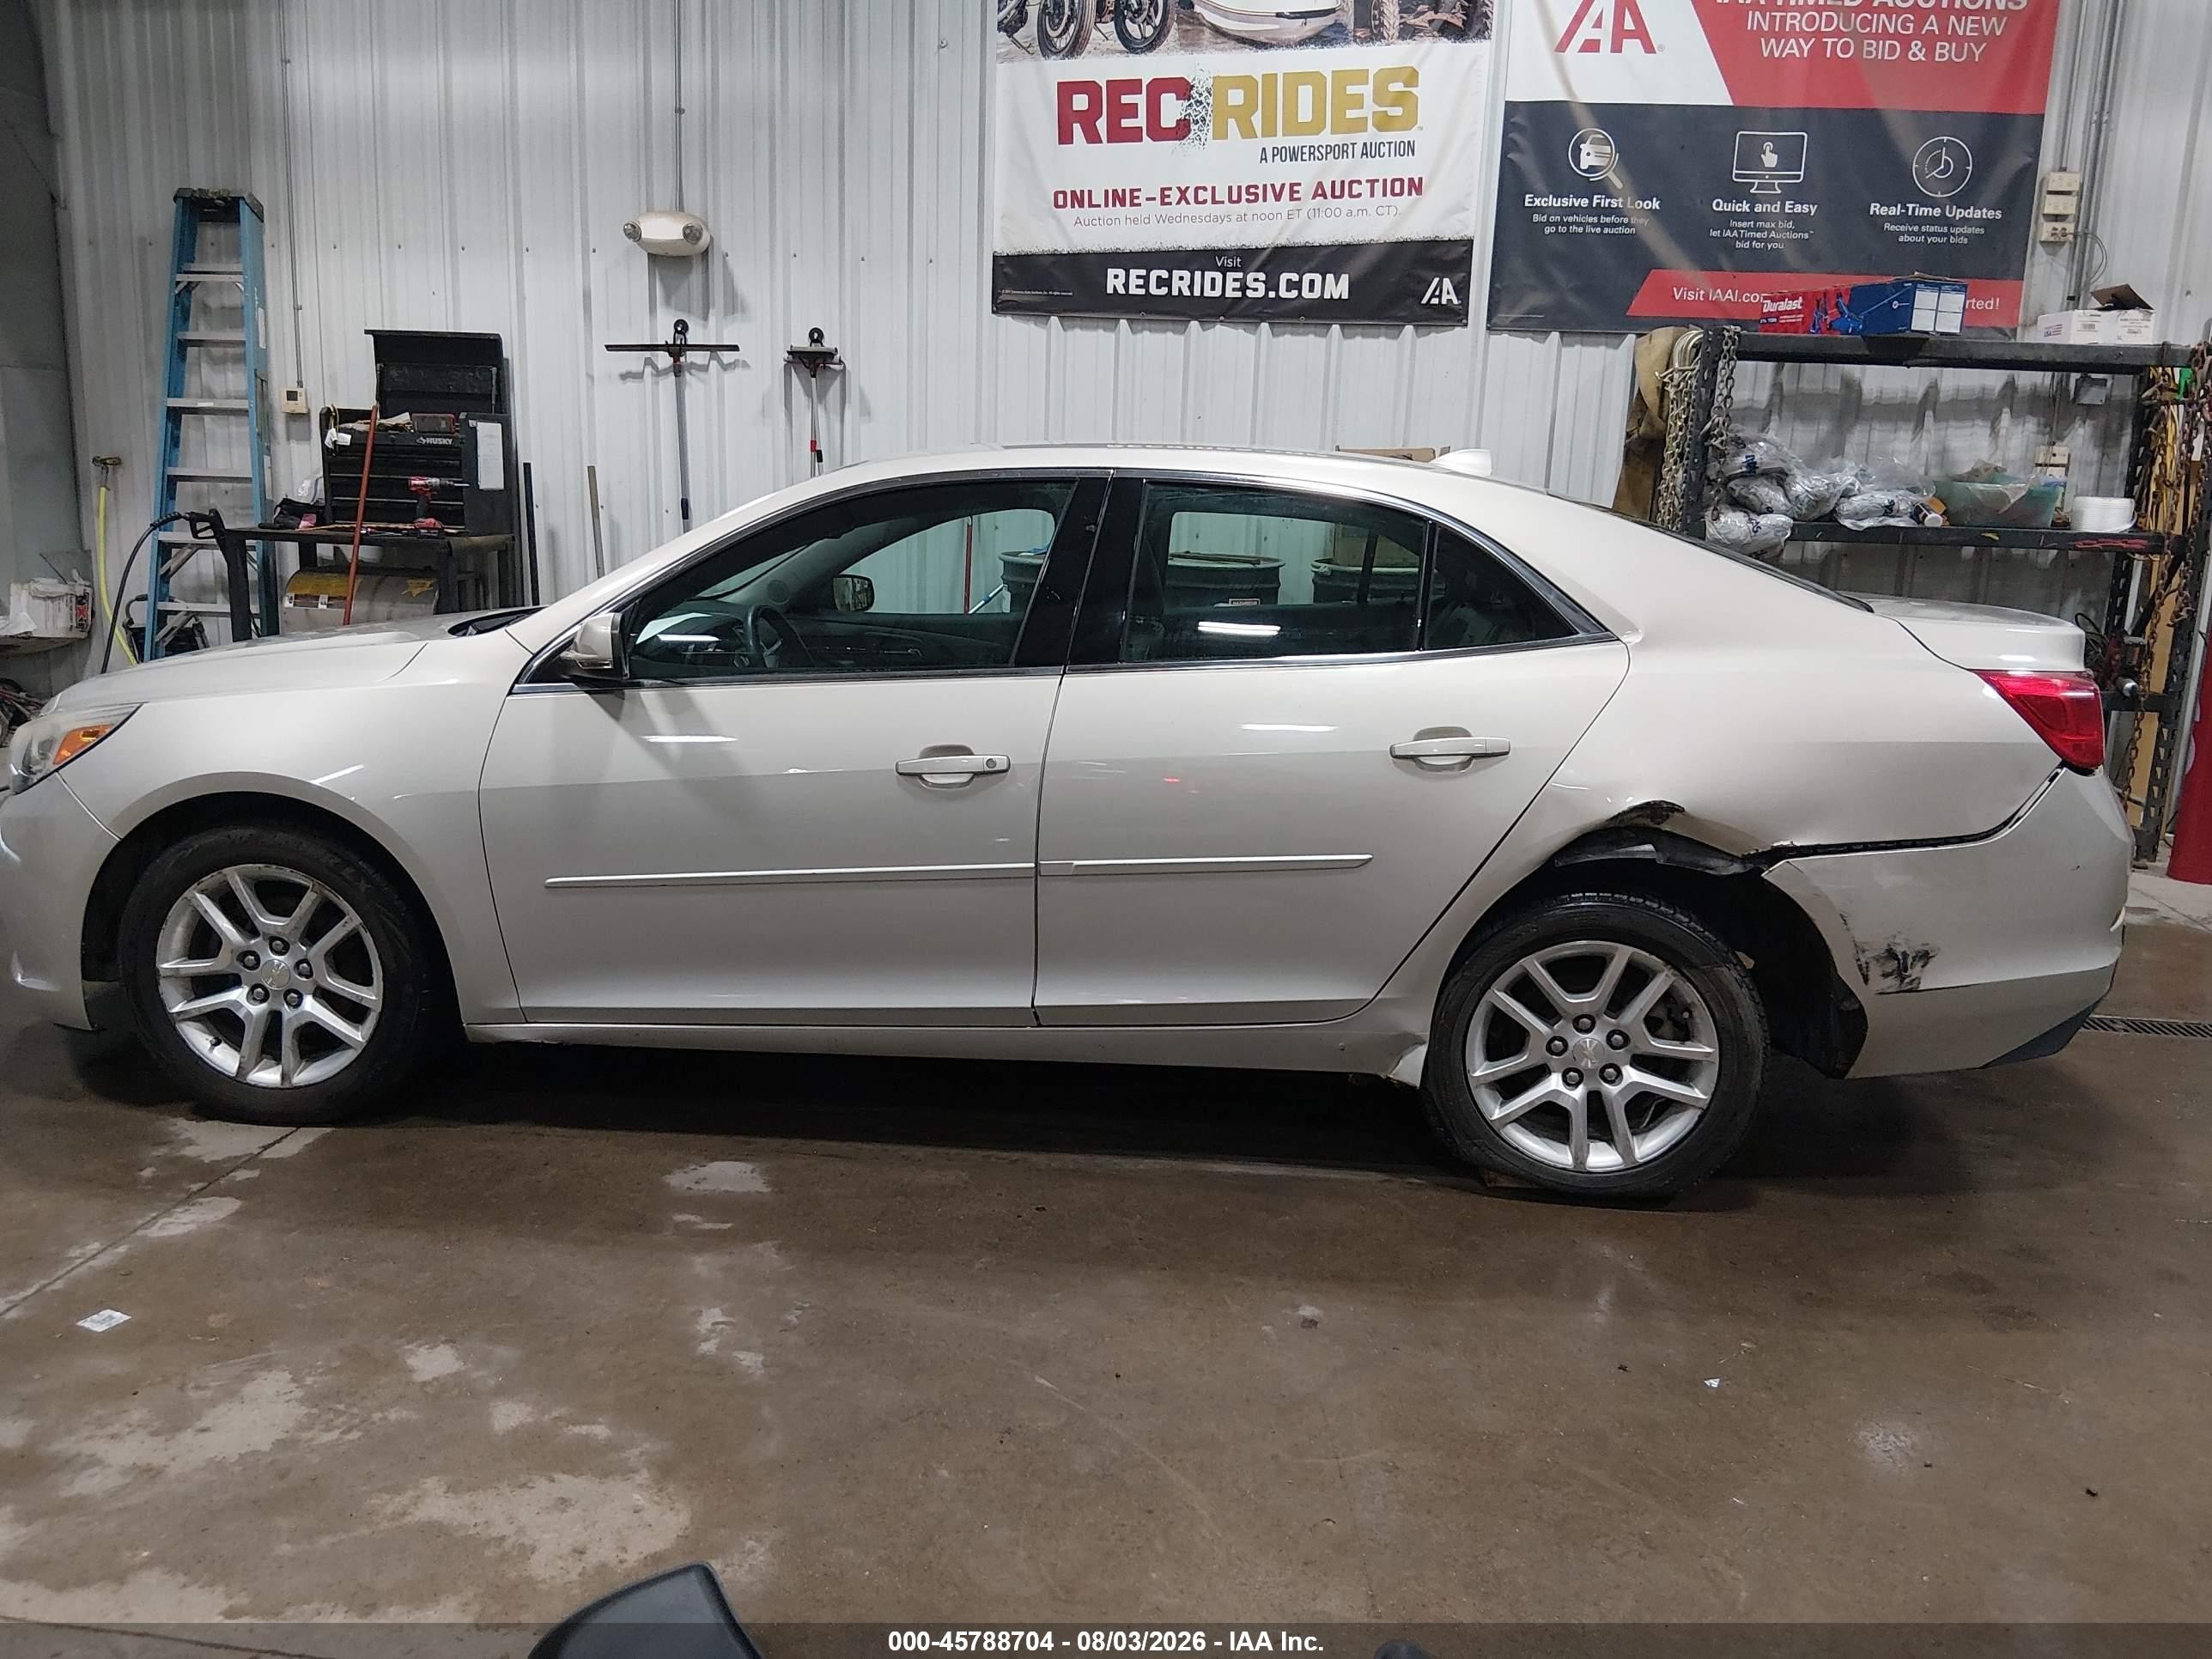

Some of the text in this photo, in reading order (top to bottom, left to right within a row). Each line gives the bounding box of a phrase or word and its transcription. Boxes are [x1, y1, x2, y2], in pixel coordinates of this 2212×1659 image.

[1747, 10, 2008, 36] INTRODUCING A NEW
[1760, 38, 1987, 63] WAY TO BID & BUY
[1057, 76, 1192, 145] REC
[1260, 140, 1415, 164] A POWERSPORT AUCTION
[1054, 177, 1424, 209] ONLINE-EXCLUSIVE AUCTION
[1524, 194, 1661, 210] Exclusive First Look
[1712, 198, 1818, 216] Quick and Easy
[1073, 205, 1401, 228] Auction held Wednesdays at noon ET (11:00 a.m. CT).
[1532, 214, 1547, 222] Bid
[1563, 215, 1598, 224] vehicles
[1600, 216, 1629, 224] before
[1631, 216, 1649, 226] they
[1869, 203, 2002, 220] Real-Time Updates
[1544, 226, 1555, 234] go
[1569, 225, 1583, 234] the
[1585, 225, 1601, 234] live
[1603, 226, 1636, 234] auction
[1729, 219, 1754, 228] Insert
[1778, 221, 1795, 229] bid,
[1884, 222, 1985, 234] Receive status updates
[1710, 228, 1721, 237] let
[1723, 229, 1738, 238] IAA
[1738, 230, 1768, 239] Timed
[1899, 234, 1969, 245] about your bids
[1735, 240, 1784, 251] bid for you
[1215, 256, 1242, 267] Visit
[1106, 268, 1349, 300] RECRIDES.COM
[1673, 287, 2000, 310] Visit IAAI.co rted!
[1763, 296, 1802, 313] Duralast
